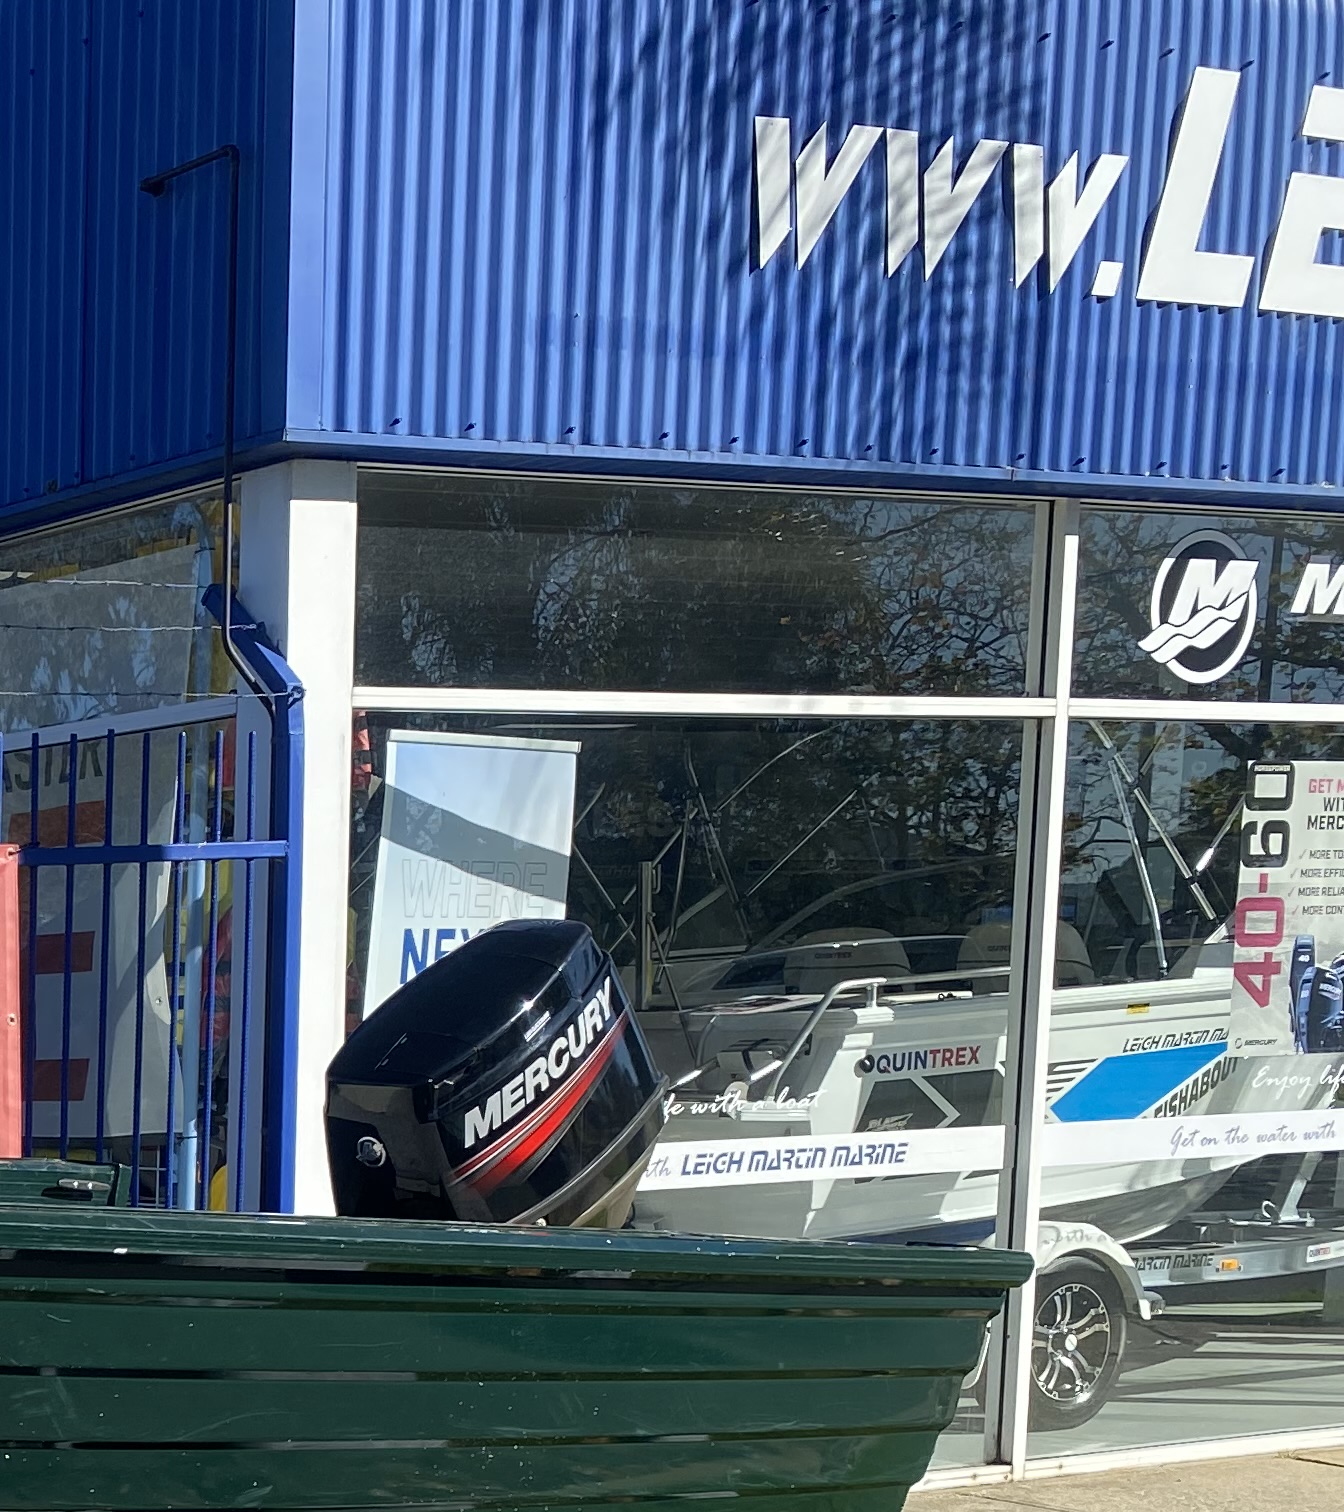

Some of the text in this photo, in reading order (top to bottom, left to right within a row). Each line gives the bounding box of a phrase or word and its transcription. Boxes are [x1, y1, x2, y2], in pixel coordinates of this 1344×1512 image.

[1308, 778, 1334, 793] GET
[1309, 849, 1331, 859] MORE
[1233, 760, 1295, 1008] 40-60
[1300, 868, 1323, 878] MORE
[401, 859, 547, 919] WHERE
[1298, 887, 1320, 896] MORE
[1302, 905, 1324, 915] MORE
[1122, 1034, 1162, 1053] LEIGH
[1161, 1029, 1210, 1049] MARTIN
[463, 975, 613, 1150] MERCURY
[876, 1045, 982, 1074] QUINTREX
[1252, 1065, 1313, 1100] Enjoy
[690, 1089, 745, 1115] with
[752, 1098, 768, 1112] a
[775, 1086, 829, 1111] boat
[1169, 1119, 1337, 1157] Get on the water with
[680, 1152, 744, 1177] LEIGH
[746, 1147, 829, 1173] MARTIN
[830, 1141, 910, 1169] MARINE
